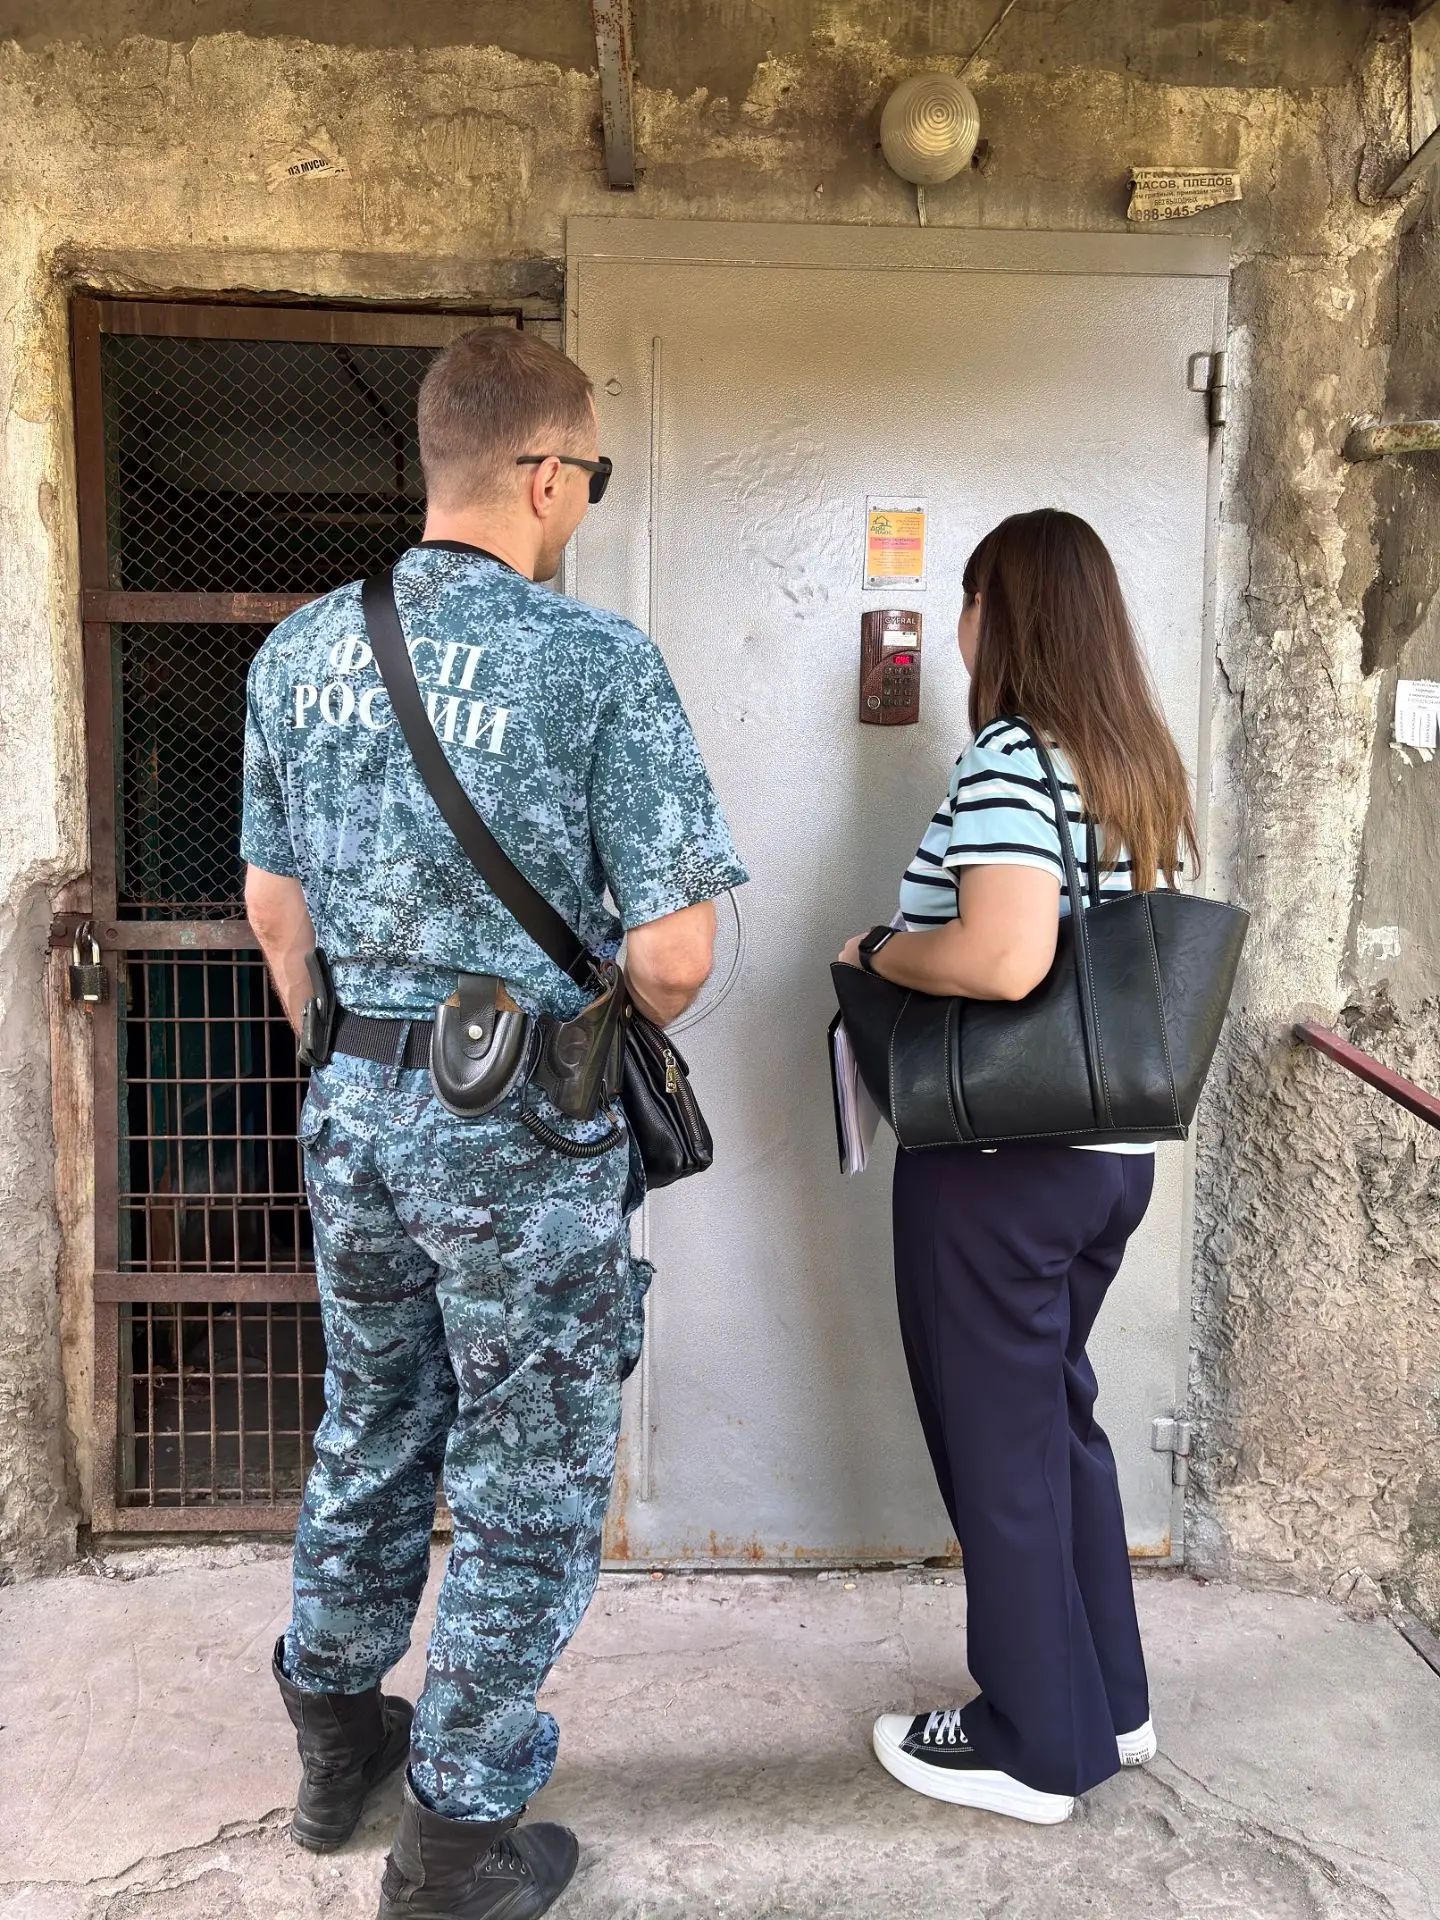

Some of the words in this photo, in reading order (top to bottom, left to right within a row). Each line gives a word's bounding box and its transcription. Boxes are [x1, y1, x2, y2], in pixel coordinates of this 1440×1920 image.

[1183, 177, 1233, 188] ПЛЕДОВ
[885, 616, 916, 625] CYFRAL
[329, 634, 485, 691] ФСП
[291, 681, 514, 756] РОСИИ
